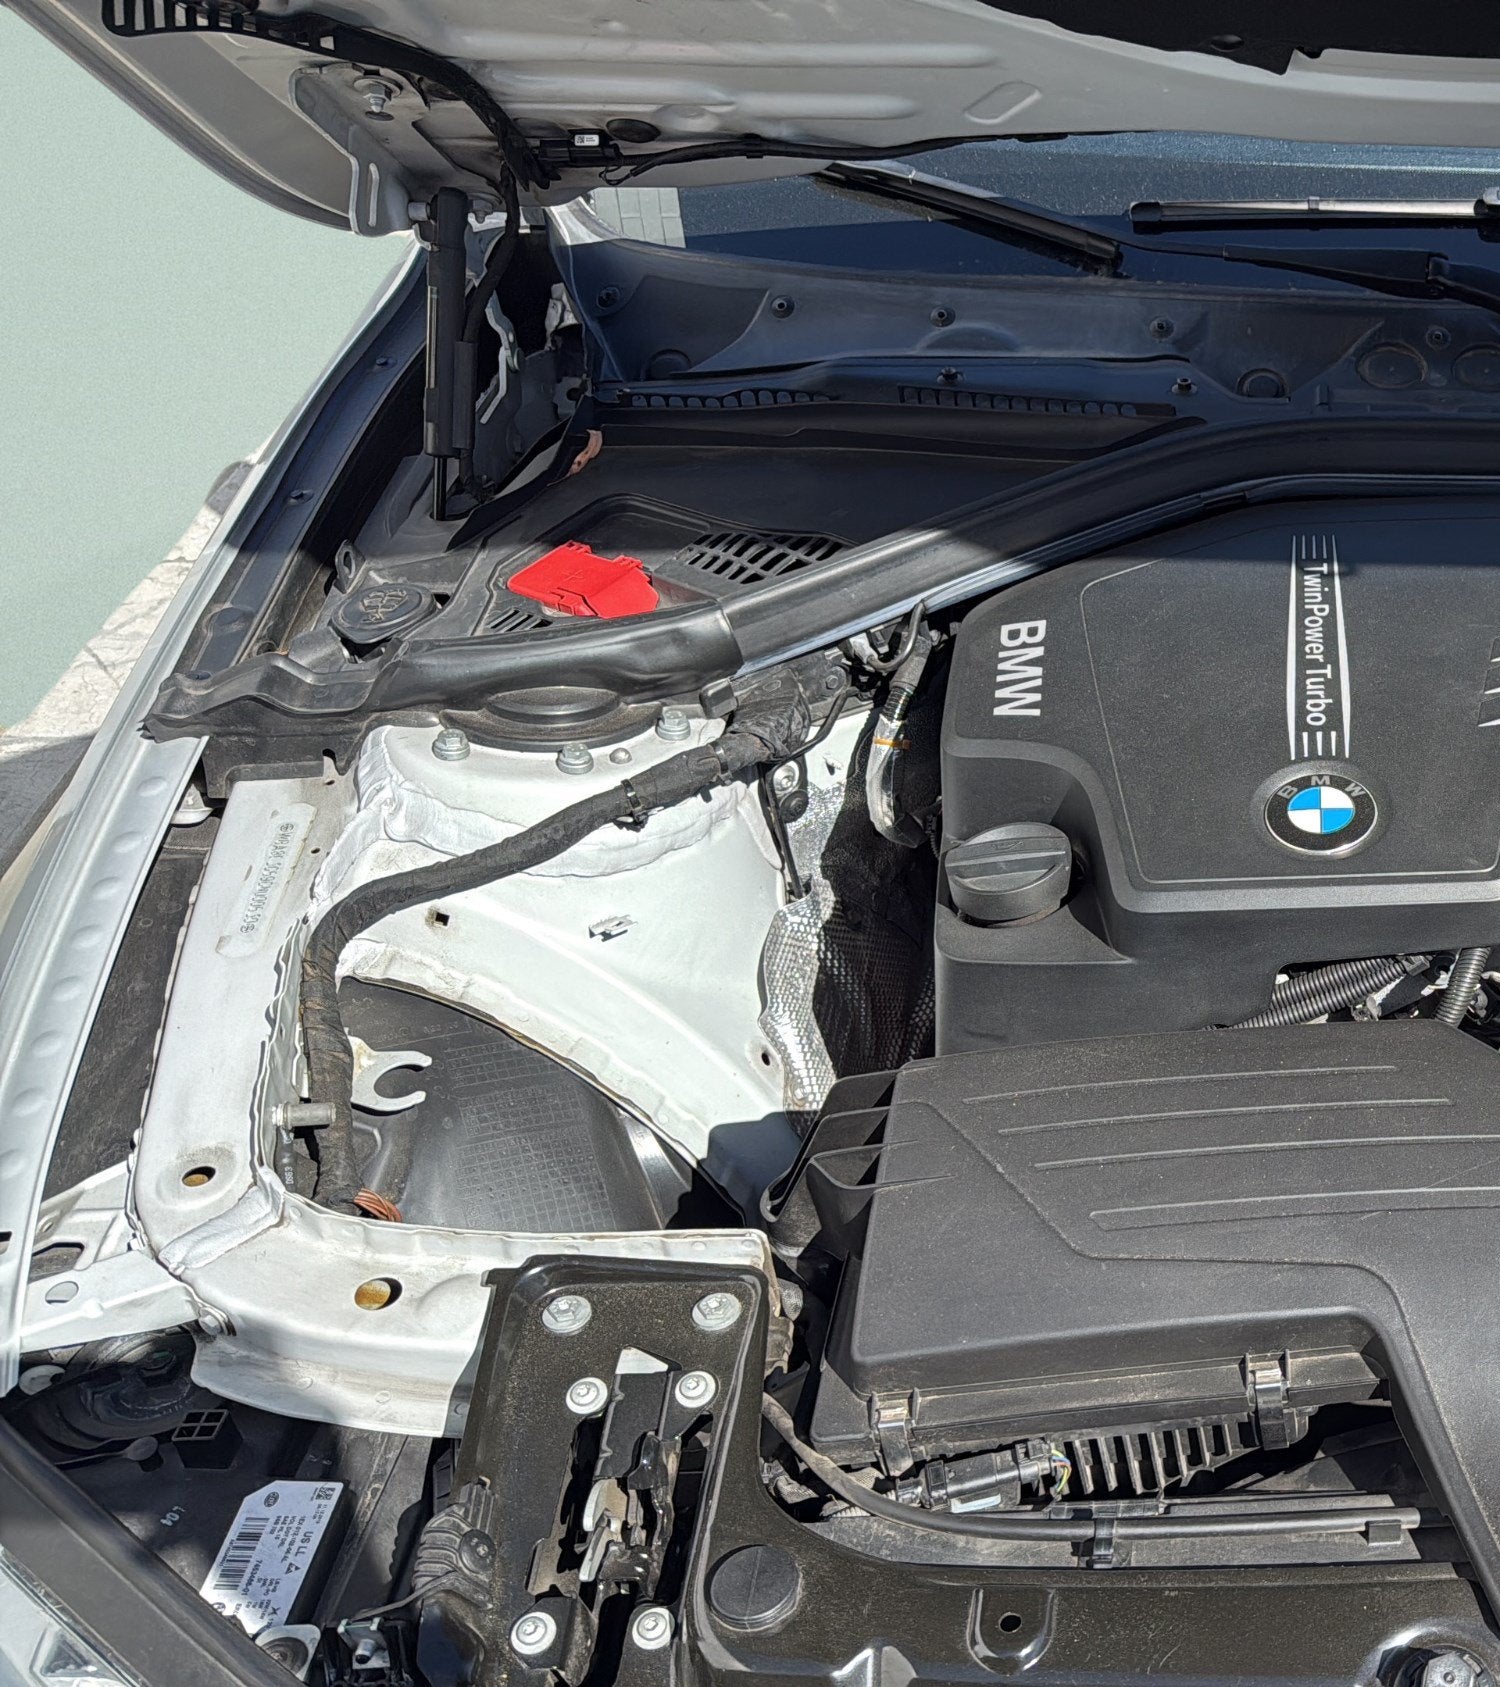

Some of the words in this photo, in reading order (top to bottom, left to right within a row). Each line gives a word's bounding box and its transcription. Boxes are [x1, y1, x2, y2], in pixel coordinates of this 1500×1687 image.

[1303, 562, 1329, 662] TwinPower
[993, 620, 1047, 716] BMW
[1305, 664, 1333, 726] Turbo
[1277, 775, 1366, 799] BMW
[293, 1546, 307, 1556] LL
[298, 1530, 313, 1543] US
